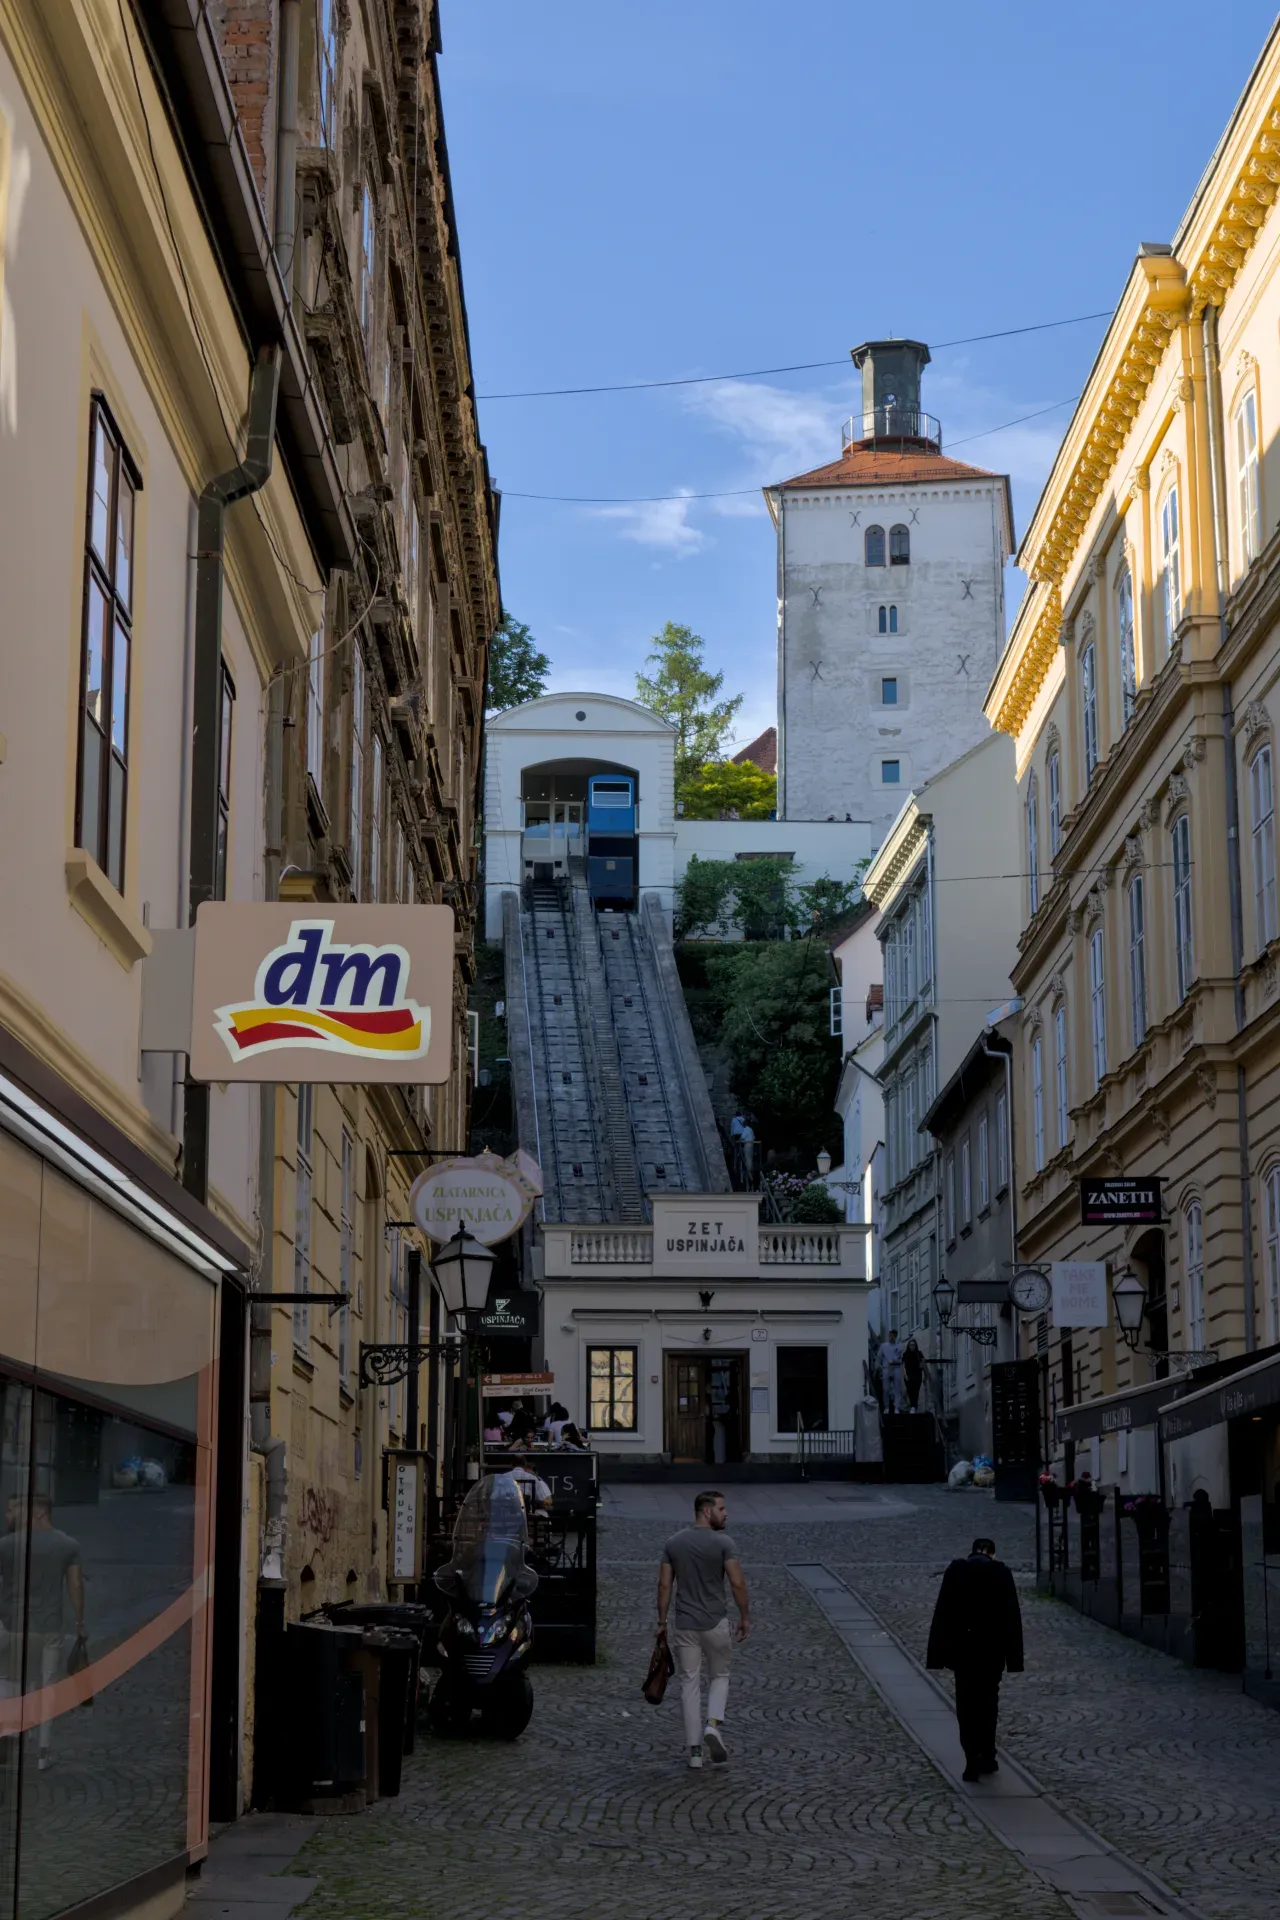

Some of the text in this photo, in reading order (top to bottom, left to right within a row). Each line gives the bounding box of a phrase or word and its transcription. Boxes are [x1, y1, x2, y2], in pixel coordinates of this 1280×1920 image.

[263, 929, 401, 1006] dm
[432, 1186, 507, 1198] ZLATARNICA
[1088, 1191, 1154, 1204] ZANETTI
[424, 1203, 513, 1223] USPINJAČA
[688, 1222, 723, 1235] ZET
[667, 1236, 744, 1252] USPINJAČA
[1062, 1268, 1096, 1281] TAKE
[1069, 1282, 1091, 1295] ME
[1060, 1296, 1099, 1309] HOME
[481, 1315, 526, 1325] USPINJAČA
